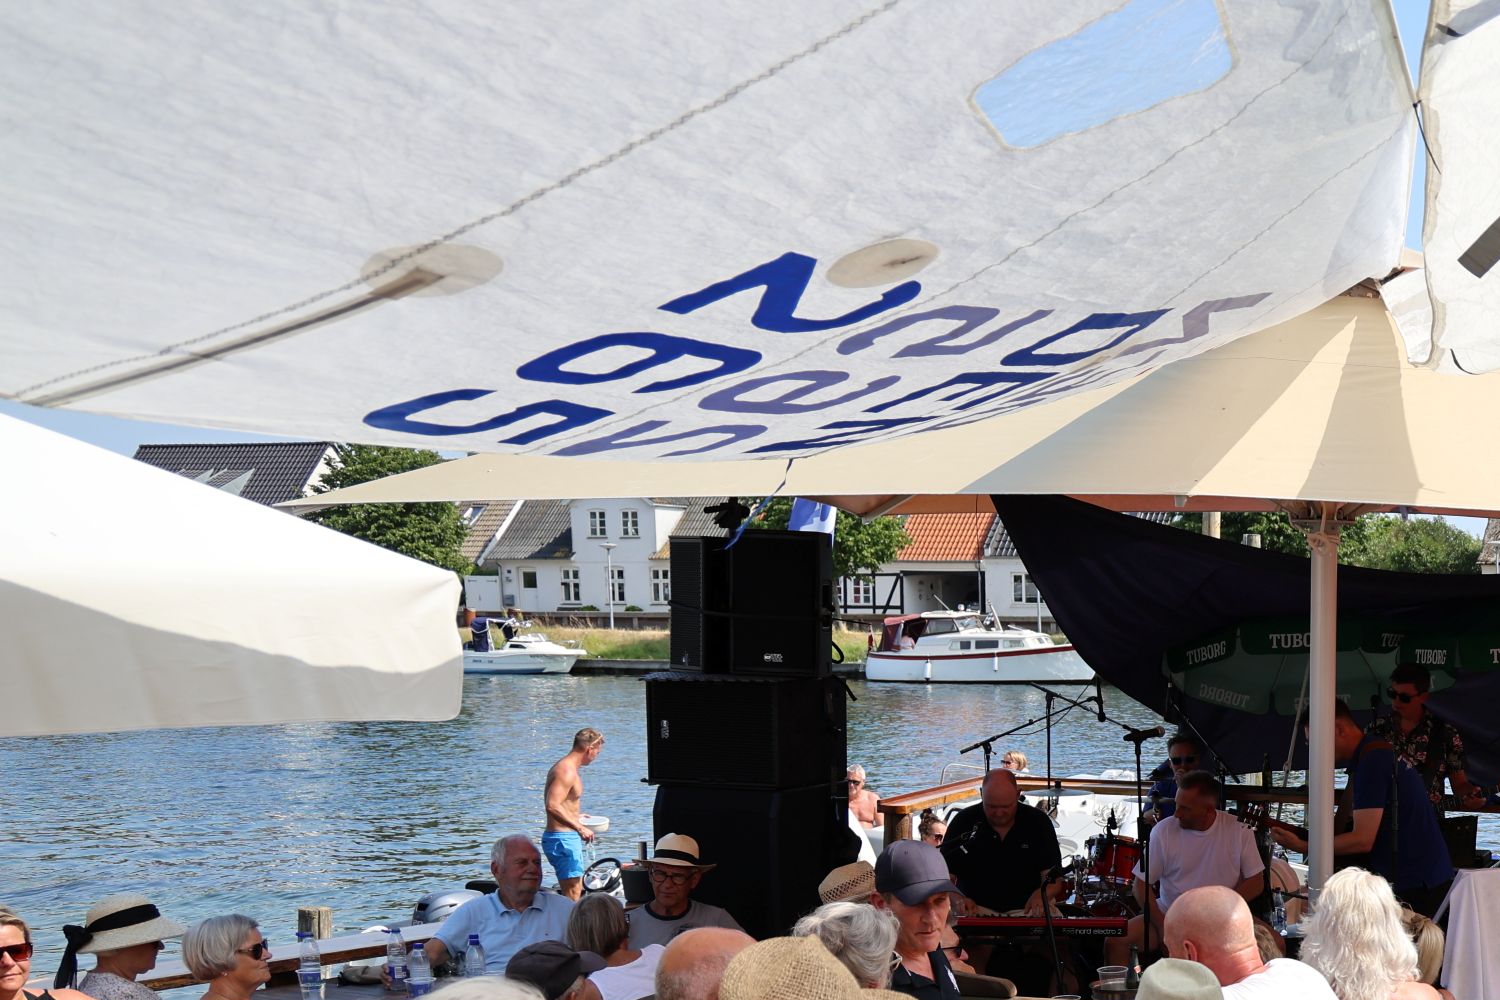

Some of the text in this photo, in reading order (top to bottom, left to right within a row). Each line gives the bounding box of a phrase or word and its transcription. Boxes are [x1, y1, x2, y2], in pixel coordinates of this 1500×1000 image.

[1269, 632, 1312, 649] TUBO
[1186, 641, 1227, 665] TUBORG
[1415, 648, 1447, 665] TUBORG
